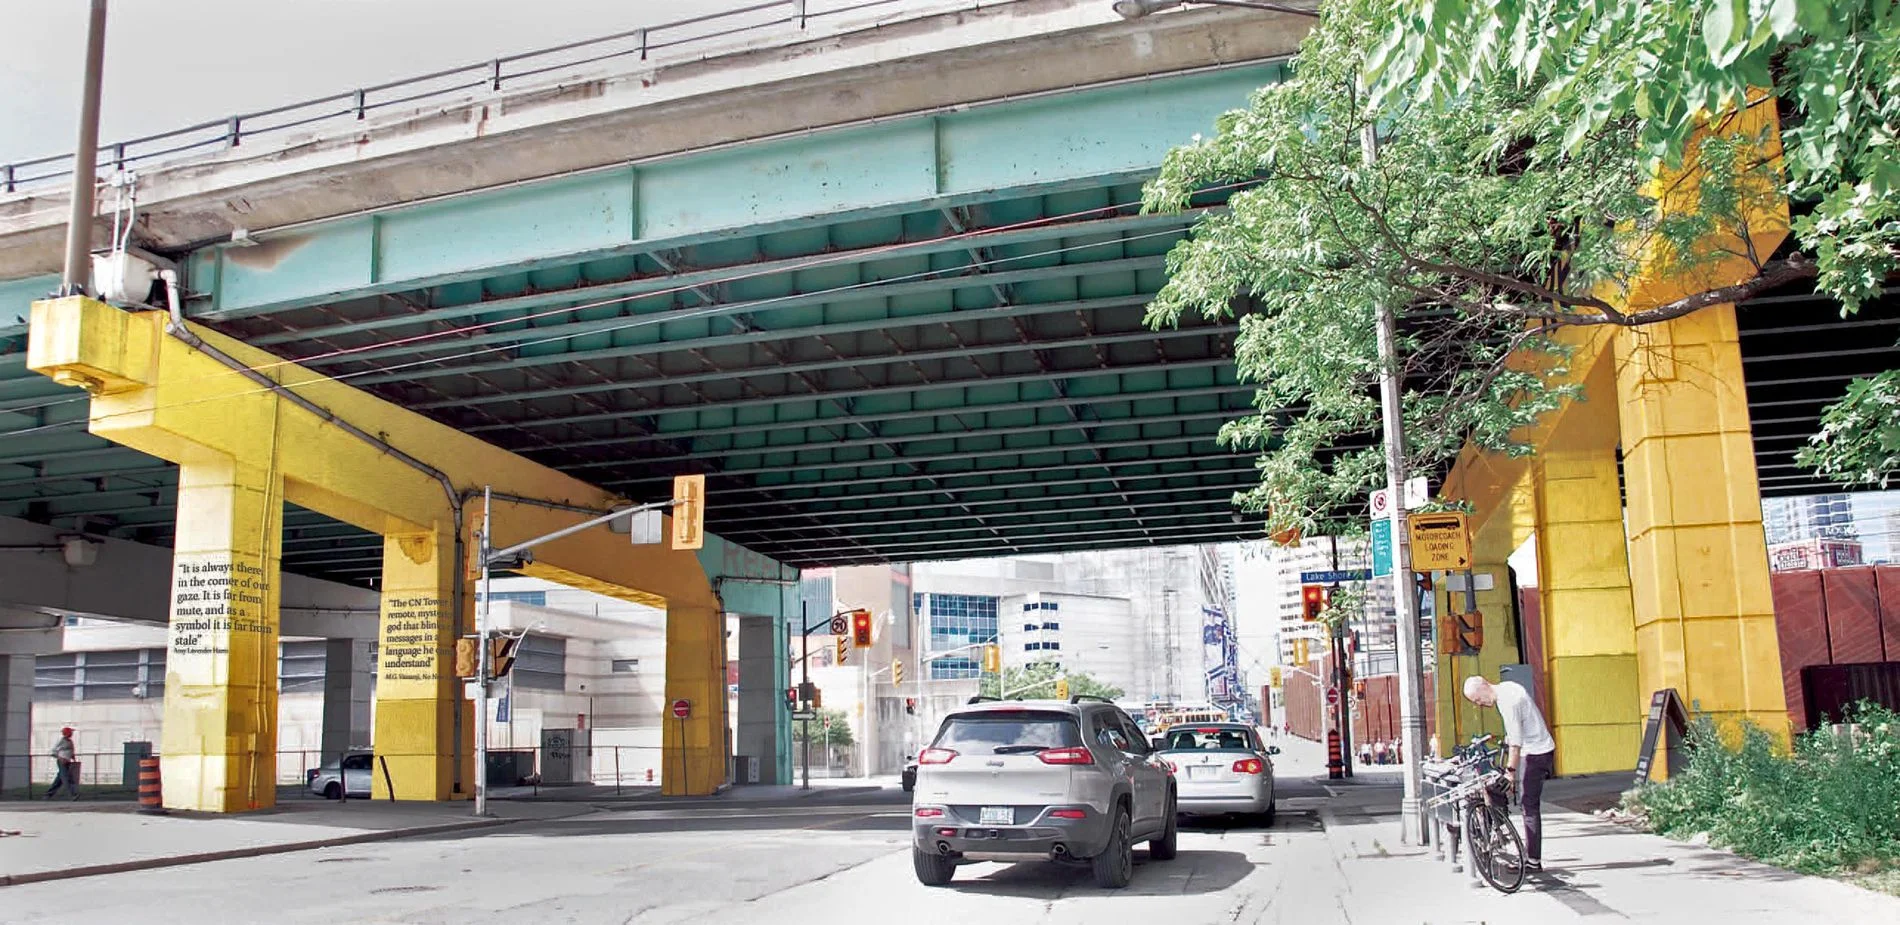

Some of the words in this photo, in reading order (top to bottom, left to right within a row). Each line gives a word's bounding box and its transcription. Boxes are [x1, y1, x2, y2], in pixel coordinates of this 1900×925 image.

[1424, 542, 1454, 552] LOADING
[1431, 552, 1448, 562] ZONE
[192, 564, 200, 573] is
[201, 562, 234, 574] always
[1306, 572, 1325, 581] Lake
[178, 577, 188, 588] in
[189, 576, 206, 587] the
[207, 578, 239, 587] corner
[240, 577, 252, 588] of
[252, 583, 270, 591] our
[202, 590, 210, 600] It
[212, 590, 221, 600] is
[223, 589, 237, 600] far
[408, 599, 422, 607] CN
[176, 606, 203, 616] mute,
[204, 604, 224, 615] and
[226, 606, 237, 616] as
[239, 608, 246, 617] a
[175, 619, 211, 633] symbol
[213, 619, 220, 630] it
[223, 619, 232, 630] is
[234, 620, 248, 630] far
[249, 620, 272, 634] from
[387, 622, 402, 634] god
[403, 621, 419, 631] that
[386, 635, 422, 645] messages
[424, 633, 433, 642] in
[385, 644, 422, 658] language
[423, 645, 434, 655] he
[384, 656, 435, 669] understand"
